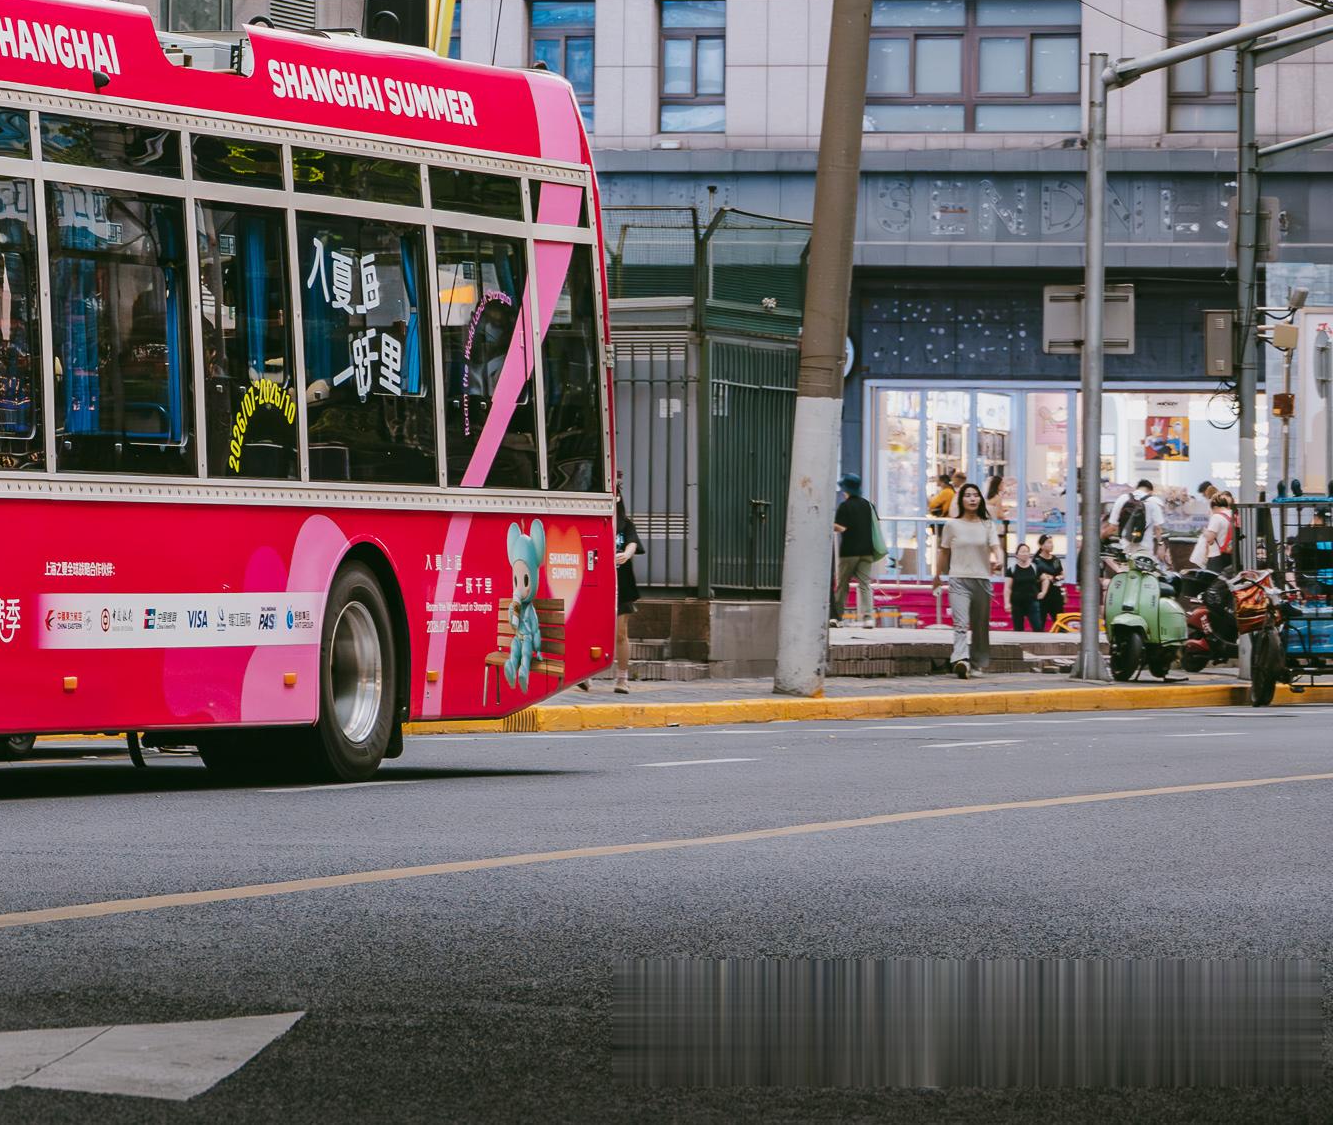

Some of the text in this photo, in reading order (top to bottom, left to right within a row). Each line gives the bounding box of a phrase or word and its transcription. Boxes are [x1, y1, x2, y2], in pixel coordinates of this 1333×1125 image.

[267, 58, 478, 127] SHANGHAI SUMMER
[549, 552, 580, 565] SHANGHAI
[552, 567, 577, 579] SUMMER
[187, 610, 208, 628] VISA
